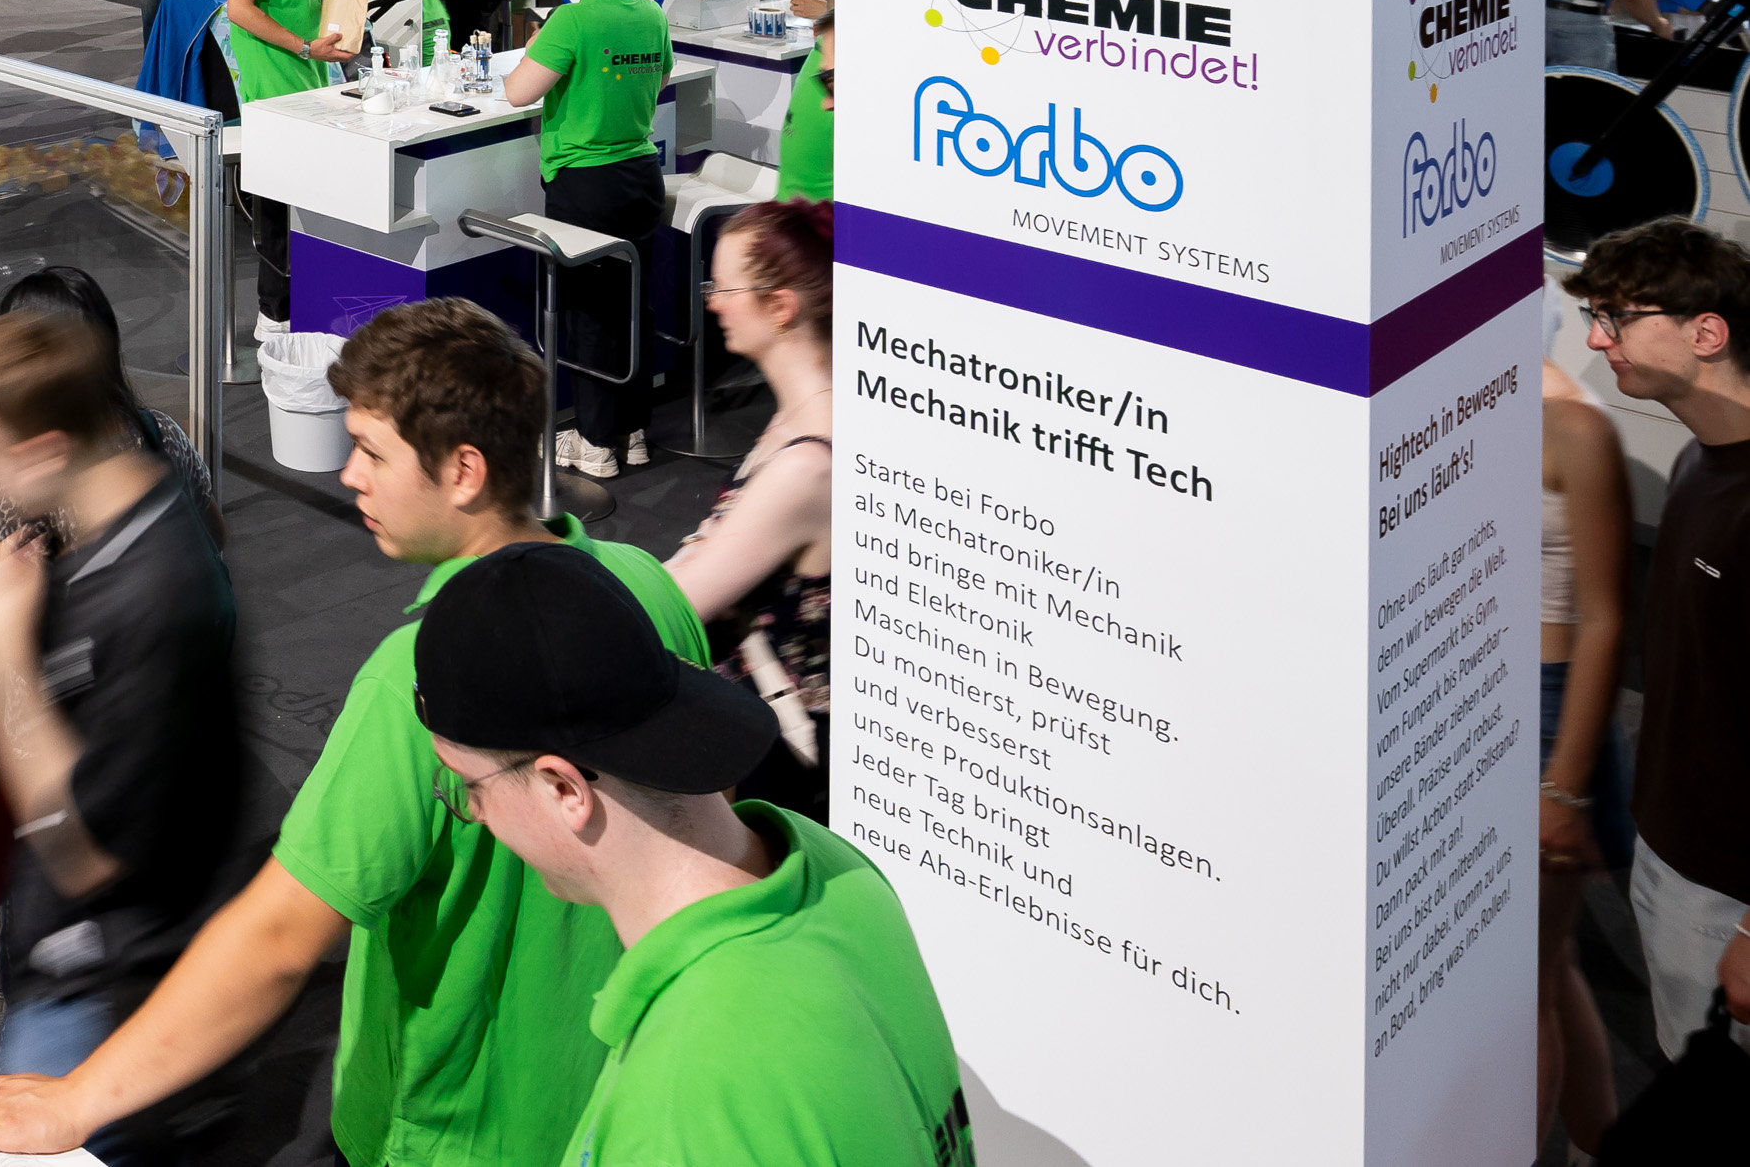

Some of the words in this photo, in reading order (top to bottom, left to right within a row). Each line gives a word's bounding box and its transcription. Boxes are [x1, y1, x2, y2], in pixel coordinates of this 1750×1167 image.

[612, 52, 662, 65] CHEMIE
[1033, 29, 1259, 92] verbindet!
[1448, 15, 1518, 77] verbindet!
[1012, 208, 1148, 256] MOVEMENT
[1159, 241, 1270, 284] SYSTEMS
[1439, 225, 1485, 267] MOVEMENT
[1487, 204, 1521, 243] SYSTEMS
[857, 321, 1169, 434] Mechatroniker/in
[1379, 414, 1438, 483] Hightech
[1441, 407, 1453, 437] in
[1457, 364, 1518, 426] Bewegung
[857, 370, 1021, 443] Mechanik
[1033, 422, 1114, 472] trifft
[1127, 448, 1213, 501] Tech
[855, 453, 926, 494] Starte
[935, 477, 971, 510] bei
[981, 494, 1056, 537] Forbo
[855, 491, 886, 520] als
[895, 503, 1120, 599] Mechatroniker/in
[1379, 493, 1400, 539] Bei
[1404, 482, 1427, 519] uns
[855, 530, 899, 560] und
[908, 543, 986, 593] bringe
[995, 576, 1037, 610] mit
[1047, 593, 1183, 662] Mechanik
[855, 566, 899, 597] und
[908, 582, 1034, 647] Elektronik
[1378, 594, 1405, 630] Ohne
[1408, 577, 1426, 605] uns
[1428, 552, 1449, 589] läuft
[1451, 543, 1466, 575] gar
[1468, 519, 1497, 555] nichts,
[854, 675, 898, 707] und
[906, 694, 1051, 771] verbesserst
[855, 599, 987, 668] Maschinen
[997, 649, 1017, 679] in
[1028, 664, 1179, 743] Bewegung.
[855, 637, 885, 665] Du
[894, 654, 1022, 723] montierst,
[1032, 706, 1111, 756] prüfst
[852, 744, 915, 788] Jeder
[924, 774, 965, 815] Tag
[974, 793, 1050, 849] bringt
[854, 711, 934, 759] unsere
[943, 744, 1221, 882] Produktionsanlagen.
[854, 783, 911, 823] neue
[919, 809, 1014, 872] Technik
[1023, 858, 1073, 897] und
[854, 819, 911, 861] neue
[919, 850, 1112, 955] Aha-Erlebnisse
[1121, 940, 1163, 977] für
[1171, 966, 1241, 1014] dich.
